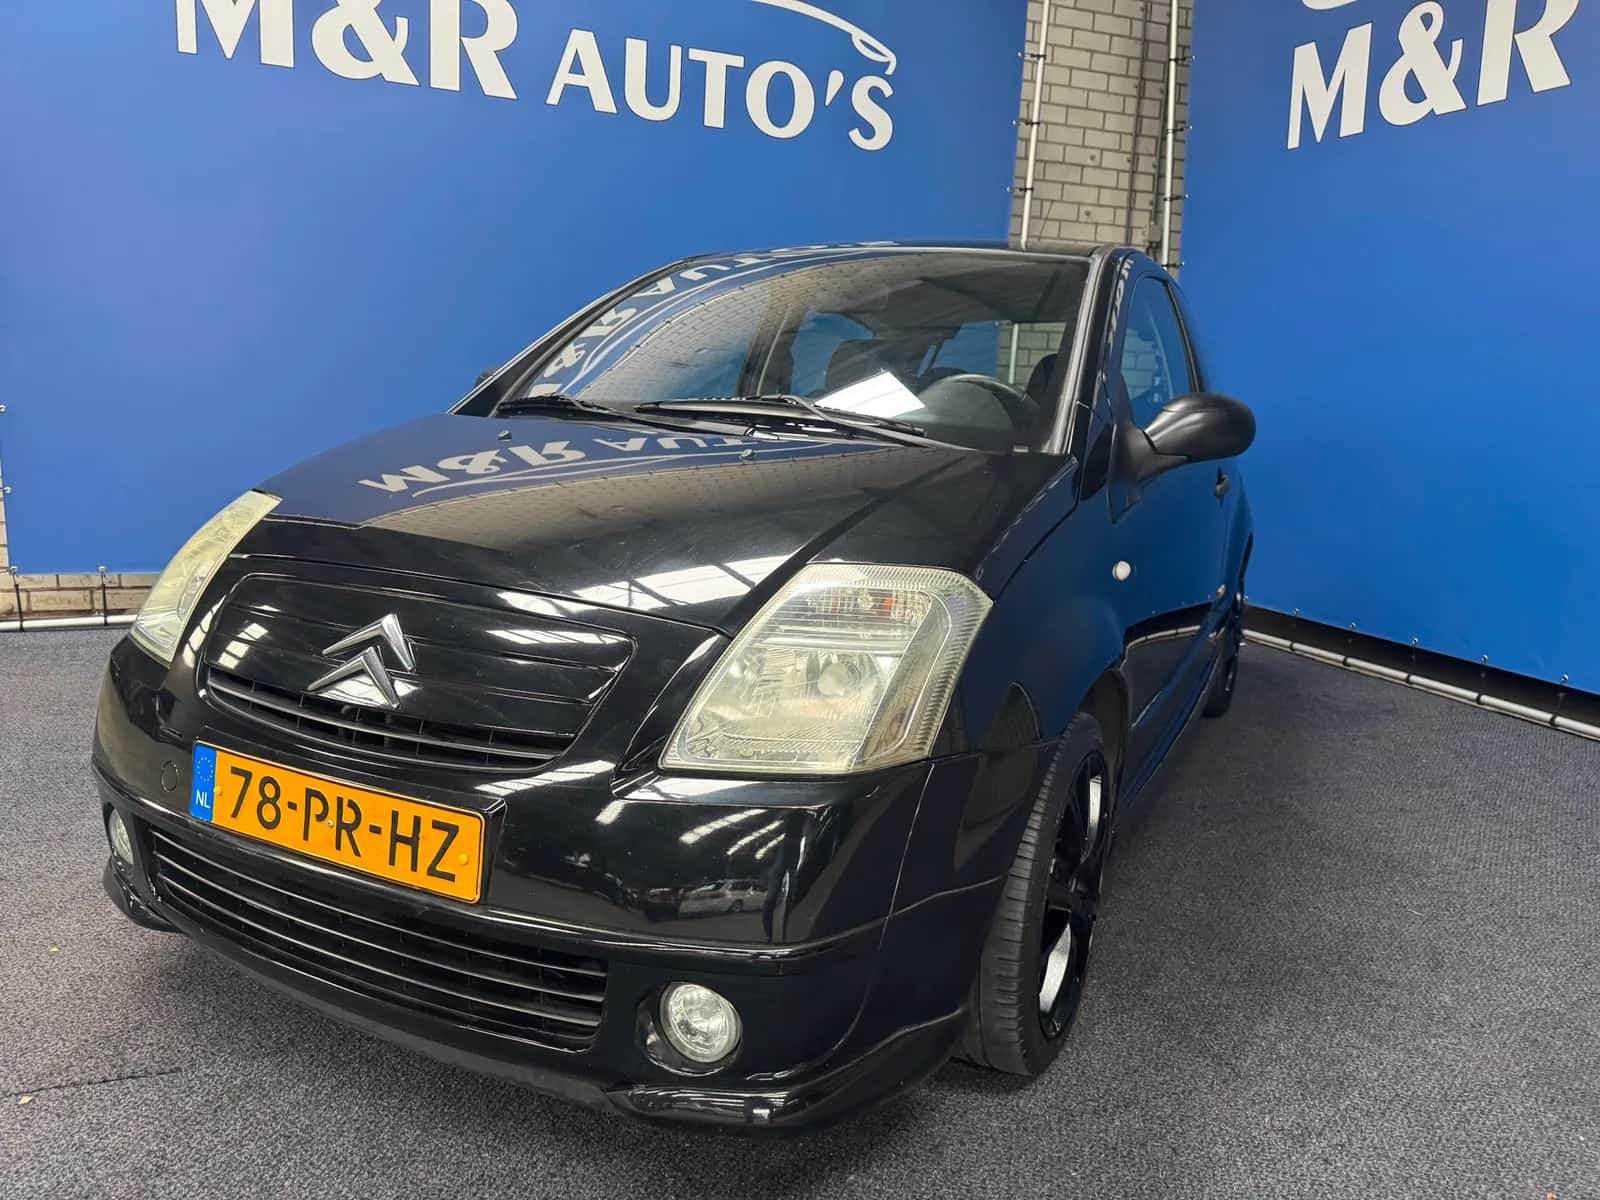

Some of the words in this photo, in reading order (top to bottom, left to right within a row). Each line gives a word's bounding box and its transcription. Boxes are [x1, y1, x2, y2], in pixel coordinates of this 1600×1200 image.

[176, 0, 518, 100] M&R
[546, 28, 894, 151] AUTO'S
[1287, 0, 1580, 150] M&R
[195, 789, 210, 809] NL
[230, 766, 459, 882] 78-PR-HZ
